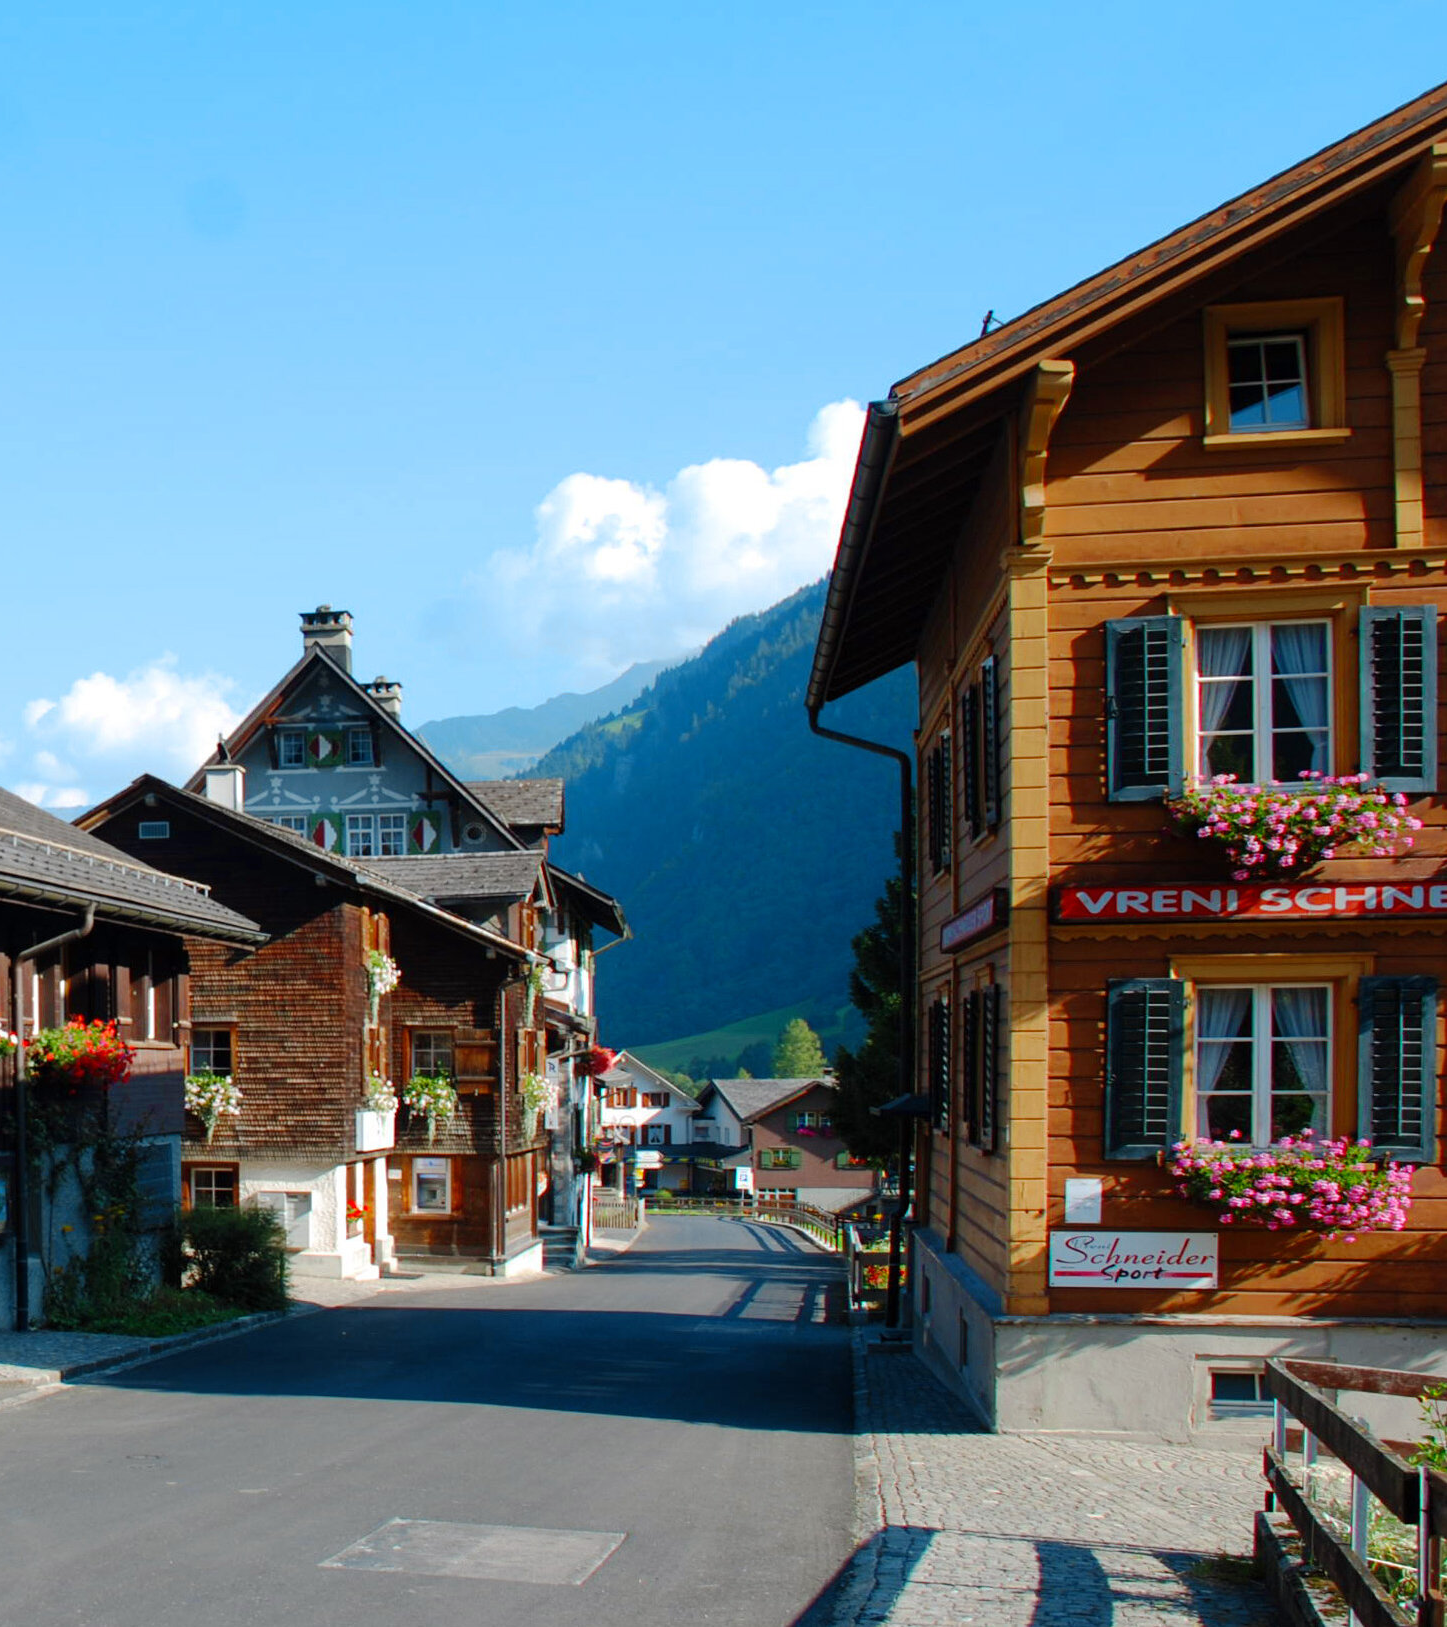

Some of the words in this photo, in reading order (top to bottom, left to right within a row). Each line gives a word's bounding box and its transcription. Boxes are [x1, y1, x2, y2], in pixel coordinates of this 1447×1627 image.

[1075, 889, 1239, 914] VRENI
[1260, 885, 1447, 912] SCHNE
[1055, 1235, 1216, 1266] Schneider
[1101, 1264, 1166, 1283] Sport
